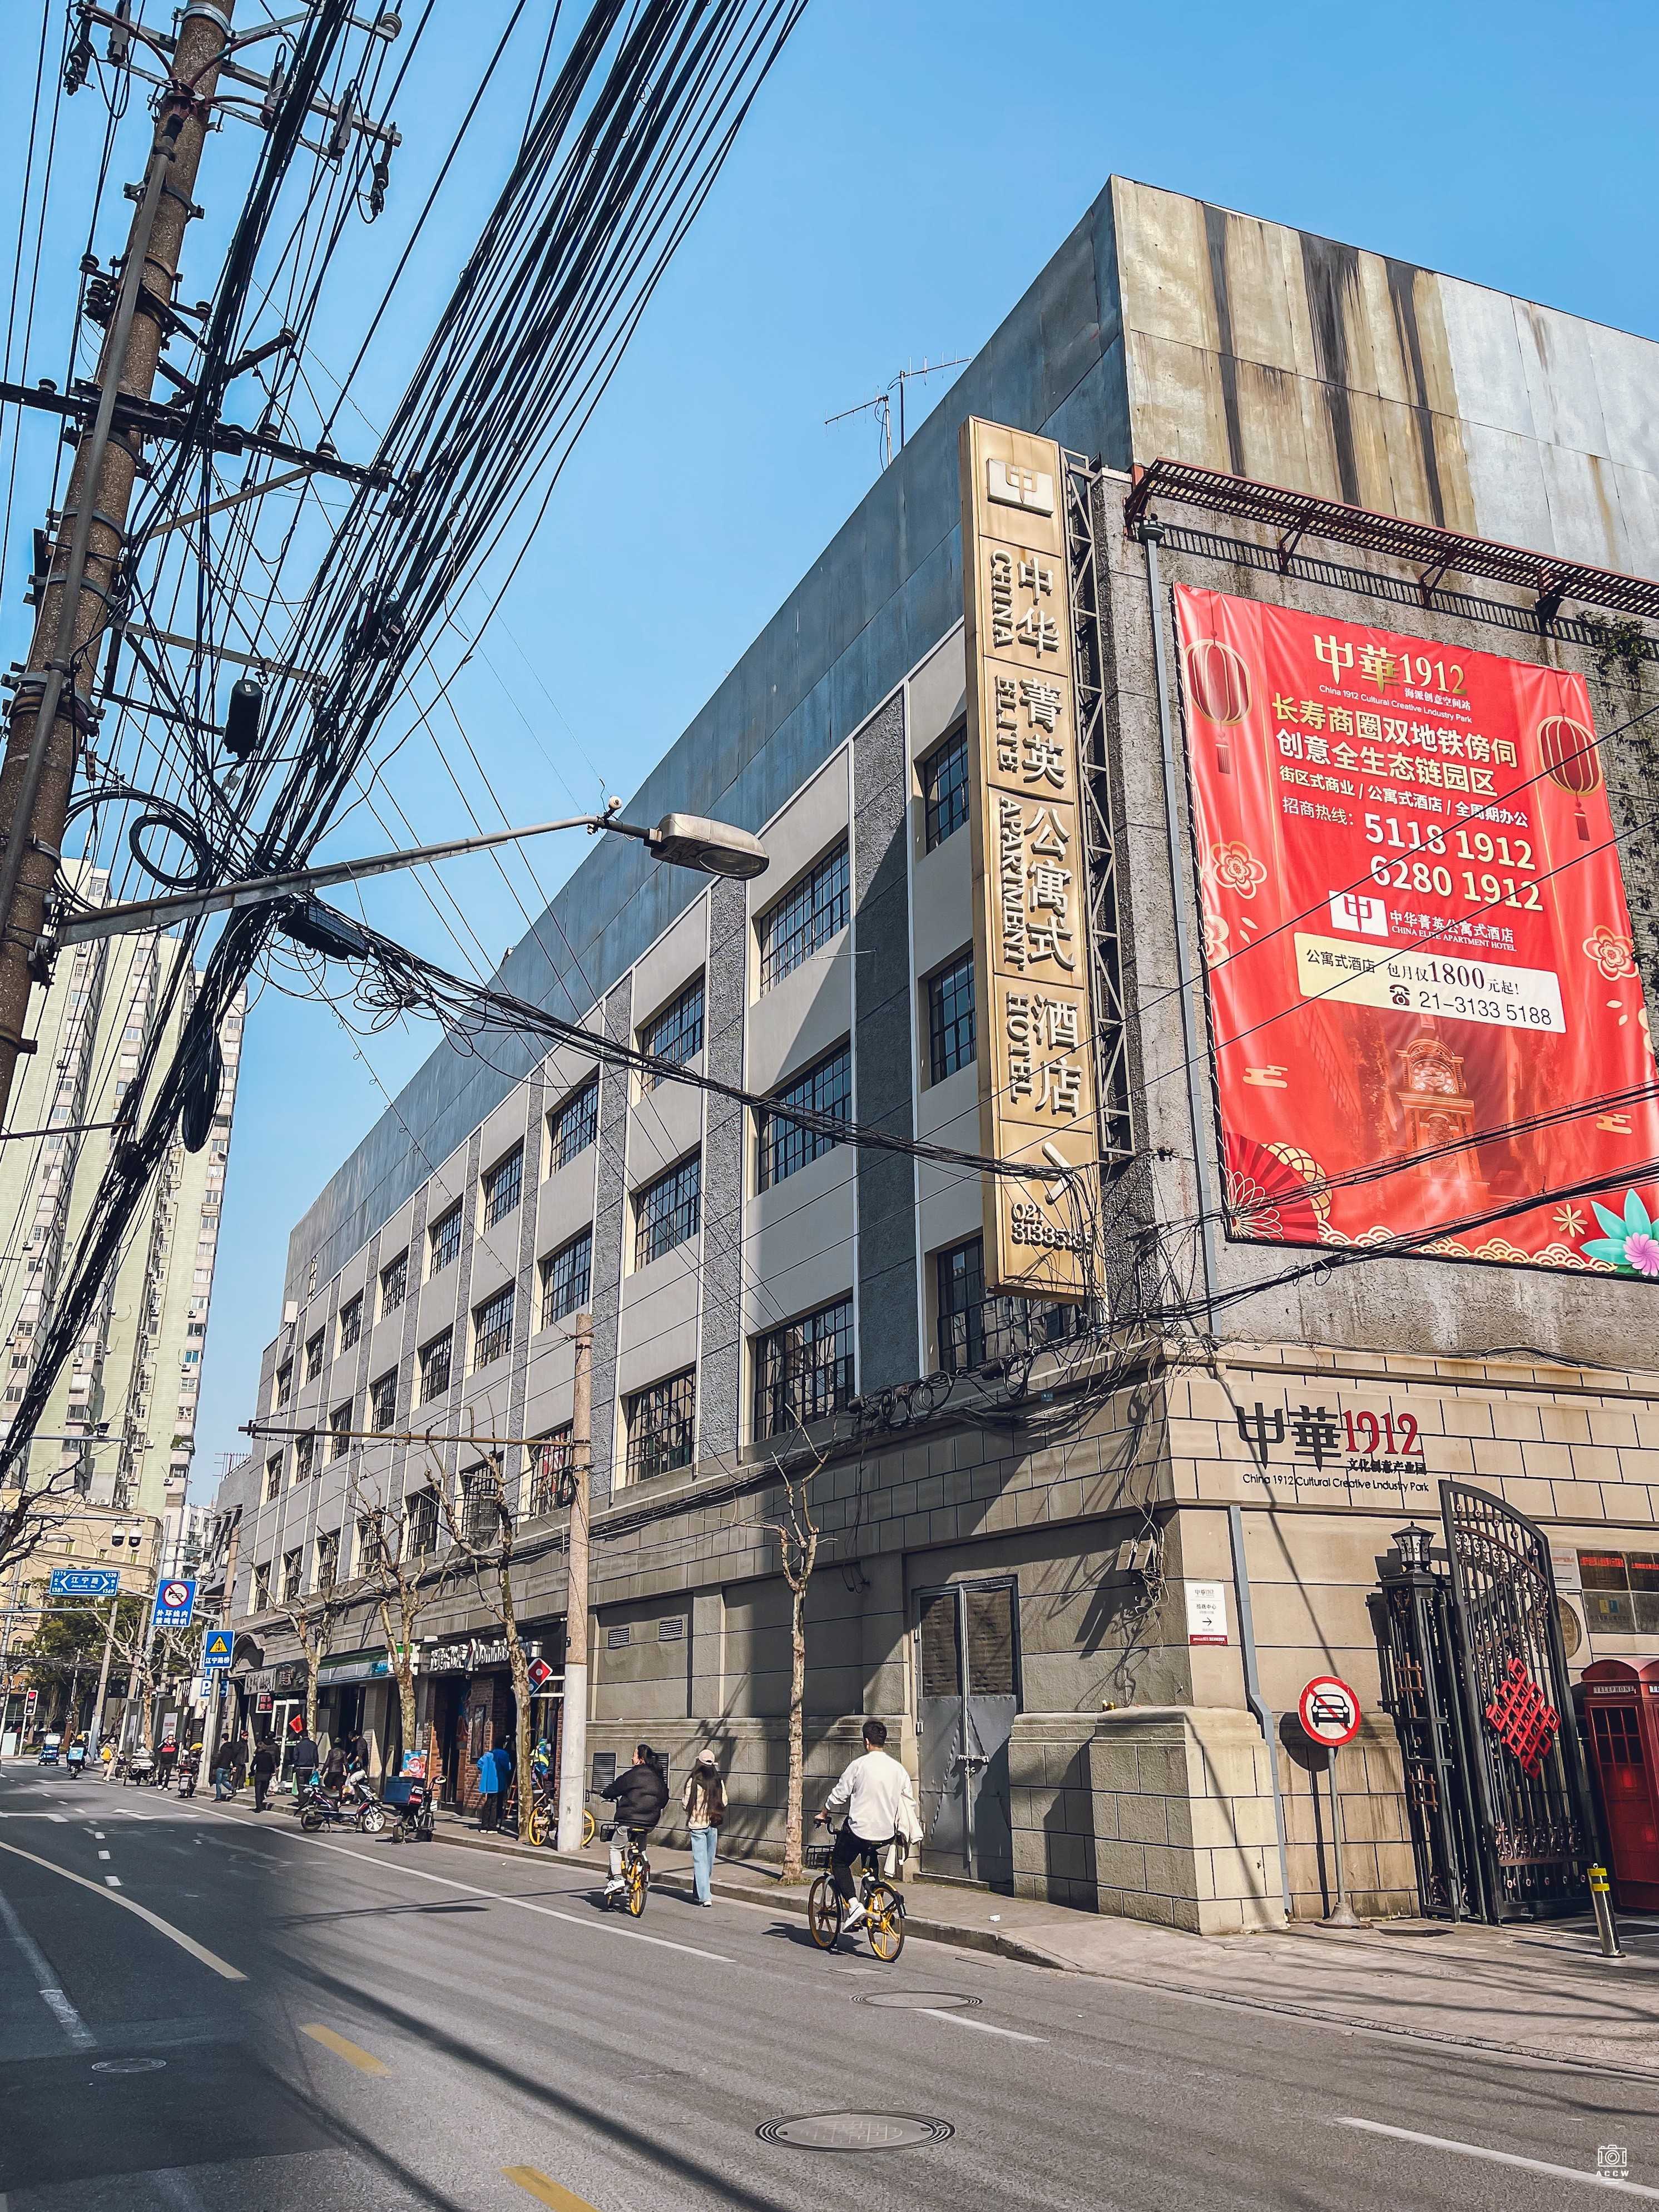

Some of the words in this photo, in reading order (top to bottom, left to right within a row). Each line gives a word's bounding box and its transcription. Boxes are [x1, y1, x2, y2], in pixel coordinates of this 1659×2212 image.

[991, 548, 1016, 650] CHINA
[994, 674, 1019, 774] ELITE
[1272, 692, 1518, 769] 长寿商圈双地铁傍伺
[1319, 685, 1341, 696] China
[1343, 690, 1359, 700] 1912
[1360, 692, 1390, 706] Cultural
[1391, 700, 1422, 713] Creative
[1455, 713, 1472, 724] Park
[1276, 728, 1498, 797] 创意全生态链园区
[1364, 812, 1447, 855] 5118
[1455, 830, 1536, 870] 1912
[999, 795, 1027, 972] APARTMENT
[1370, 855, 1452, 897] 6280
[1462, 871, 1544, 912] 1912
[1390, 909, 1514, 944] 中华菁英公寓式酒店
[1391, 926, 1418, 937] CHINA
[1443, 934, 1490, 947] APARTMENT
[1491, 942, 1518, 952] HOTEL
[1306, 948, 1375, 973] 公寓式酒店
[1507, 1004, 1552, 1026] 5188
[1006, 991, 1033, 1103] HOTEL
[1242, 1474, 1270, 1484] China
[1274, 1475, 1293, 1486] 1912
[1296, 1476, 1331, 1487] Cultural
[1333, 1477, 1371, 1489] Creative
[1411, 1482, 1429, 1492] Park
